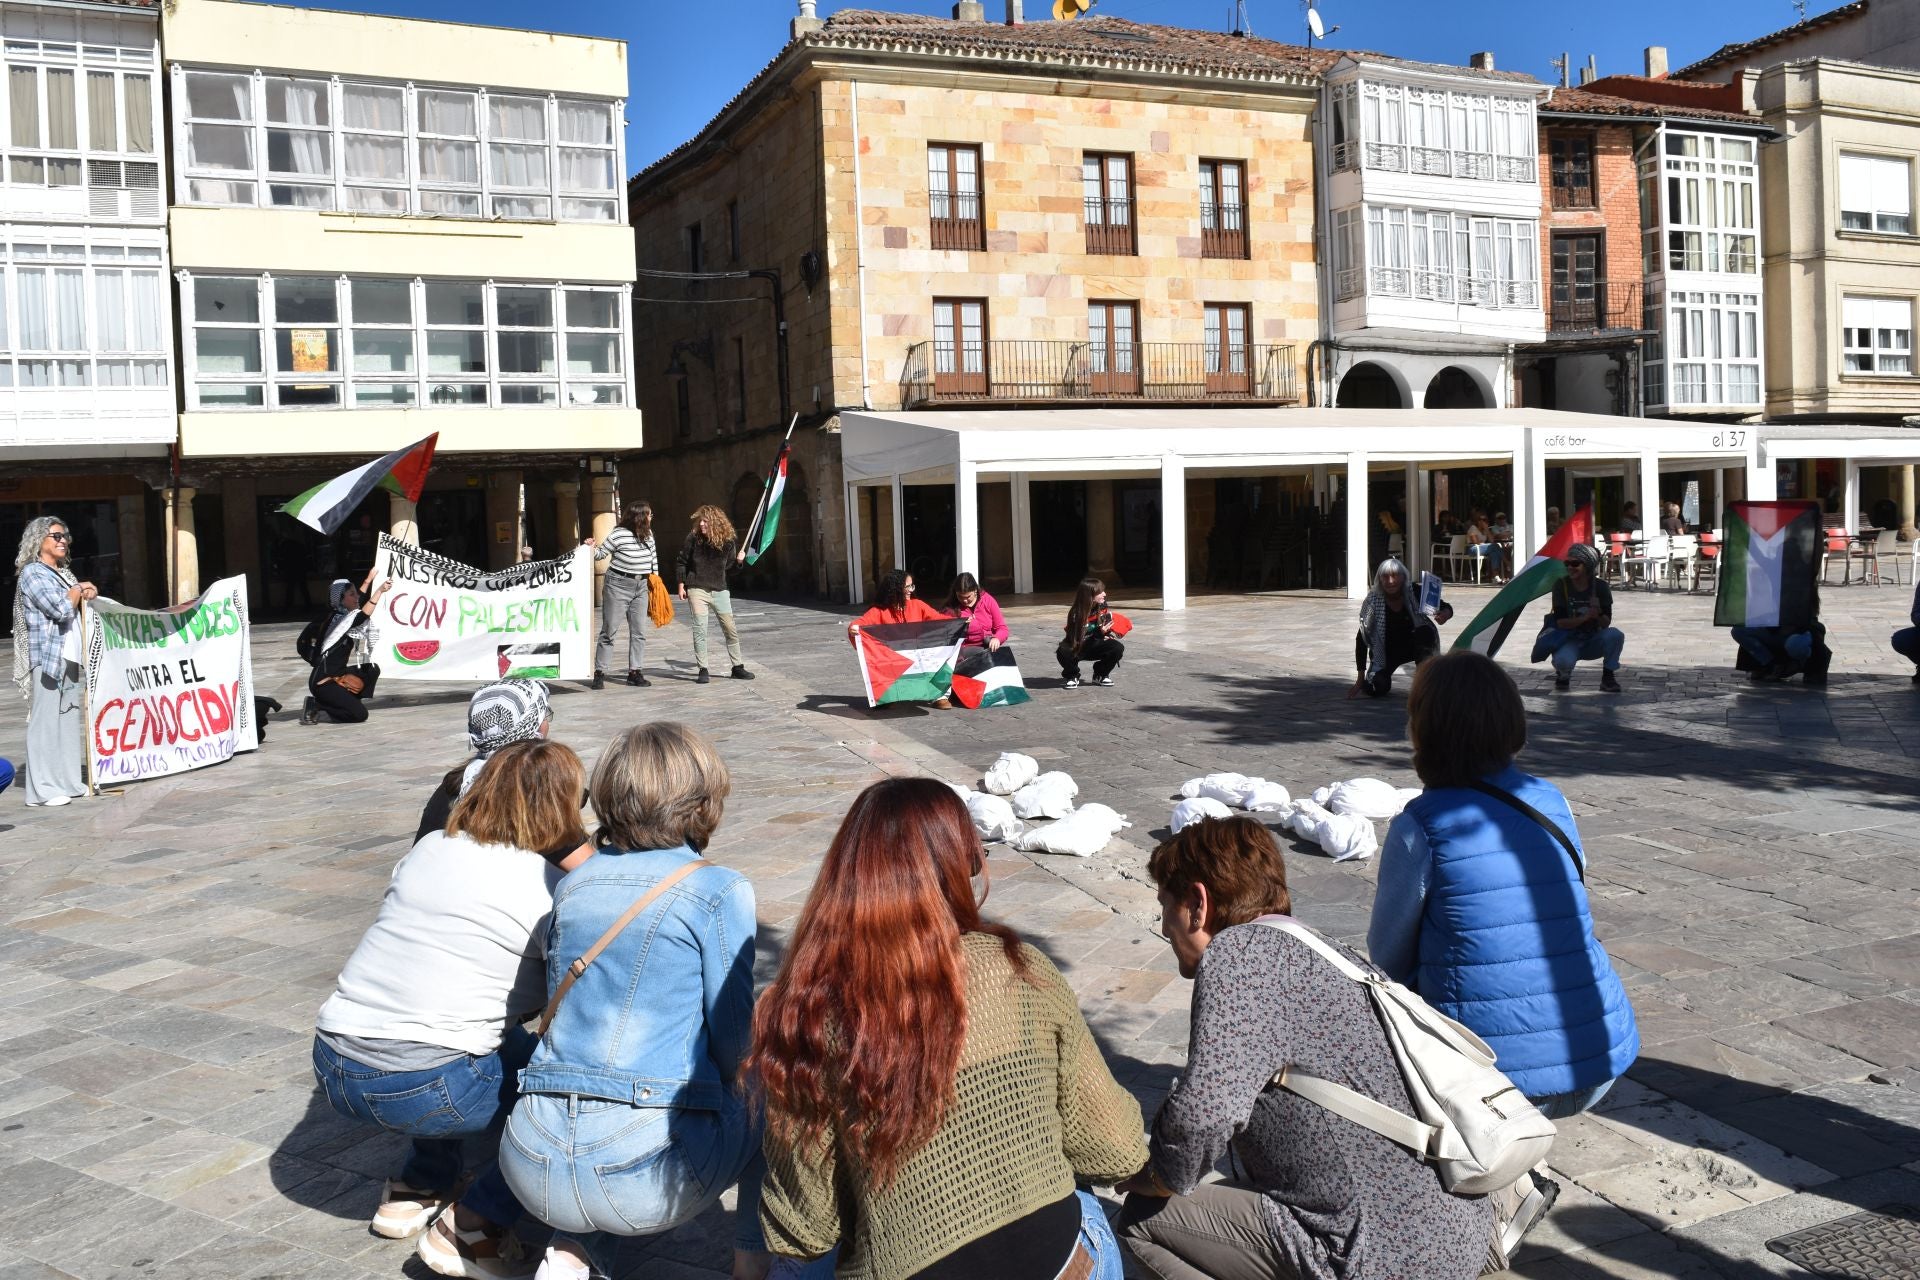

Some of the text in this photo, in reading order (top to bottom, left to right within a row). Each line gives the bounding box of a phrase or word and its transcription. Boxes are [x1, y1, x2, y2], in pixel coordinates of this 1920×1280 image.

[1544, 434, 1587, 447] café bar
[1712, 431, 1746, 448] el 37
[387, 552, 478, 591] NUESTROS
[169, 597, 239, 644] VOCES
[389, 592, 581, 637] CON PALESTINA
[126, 658, 206, 692] CONTRA EL
